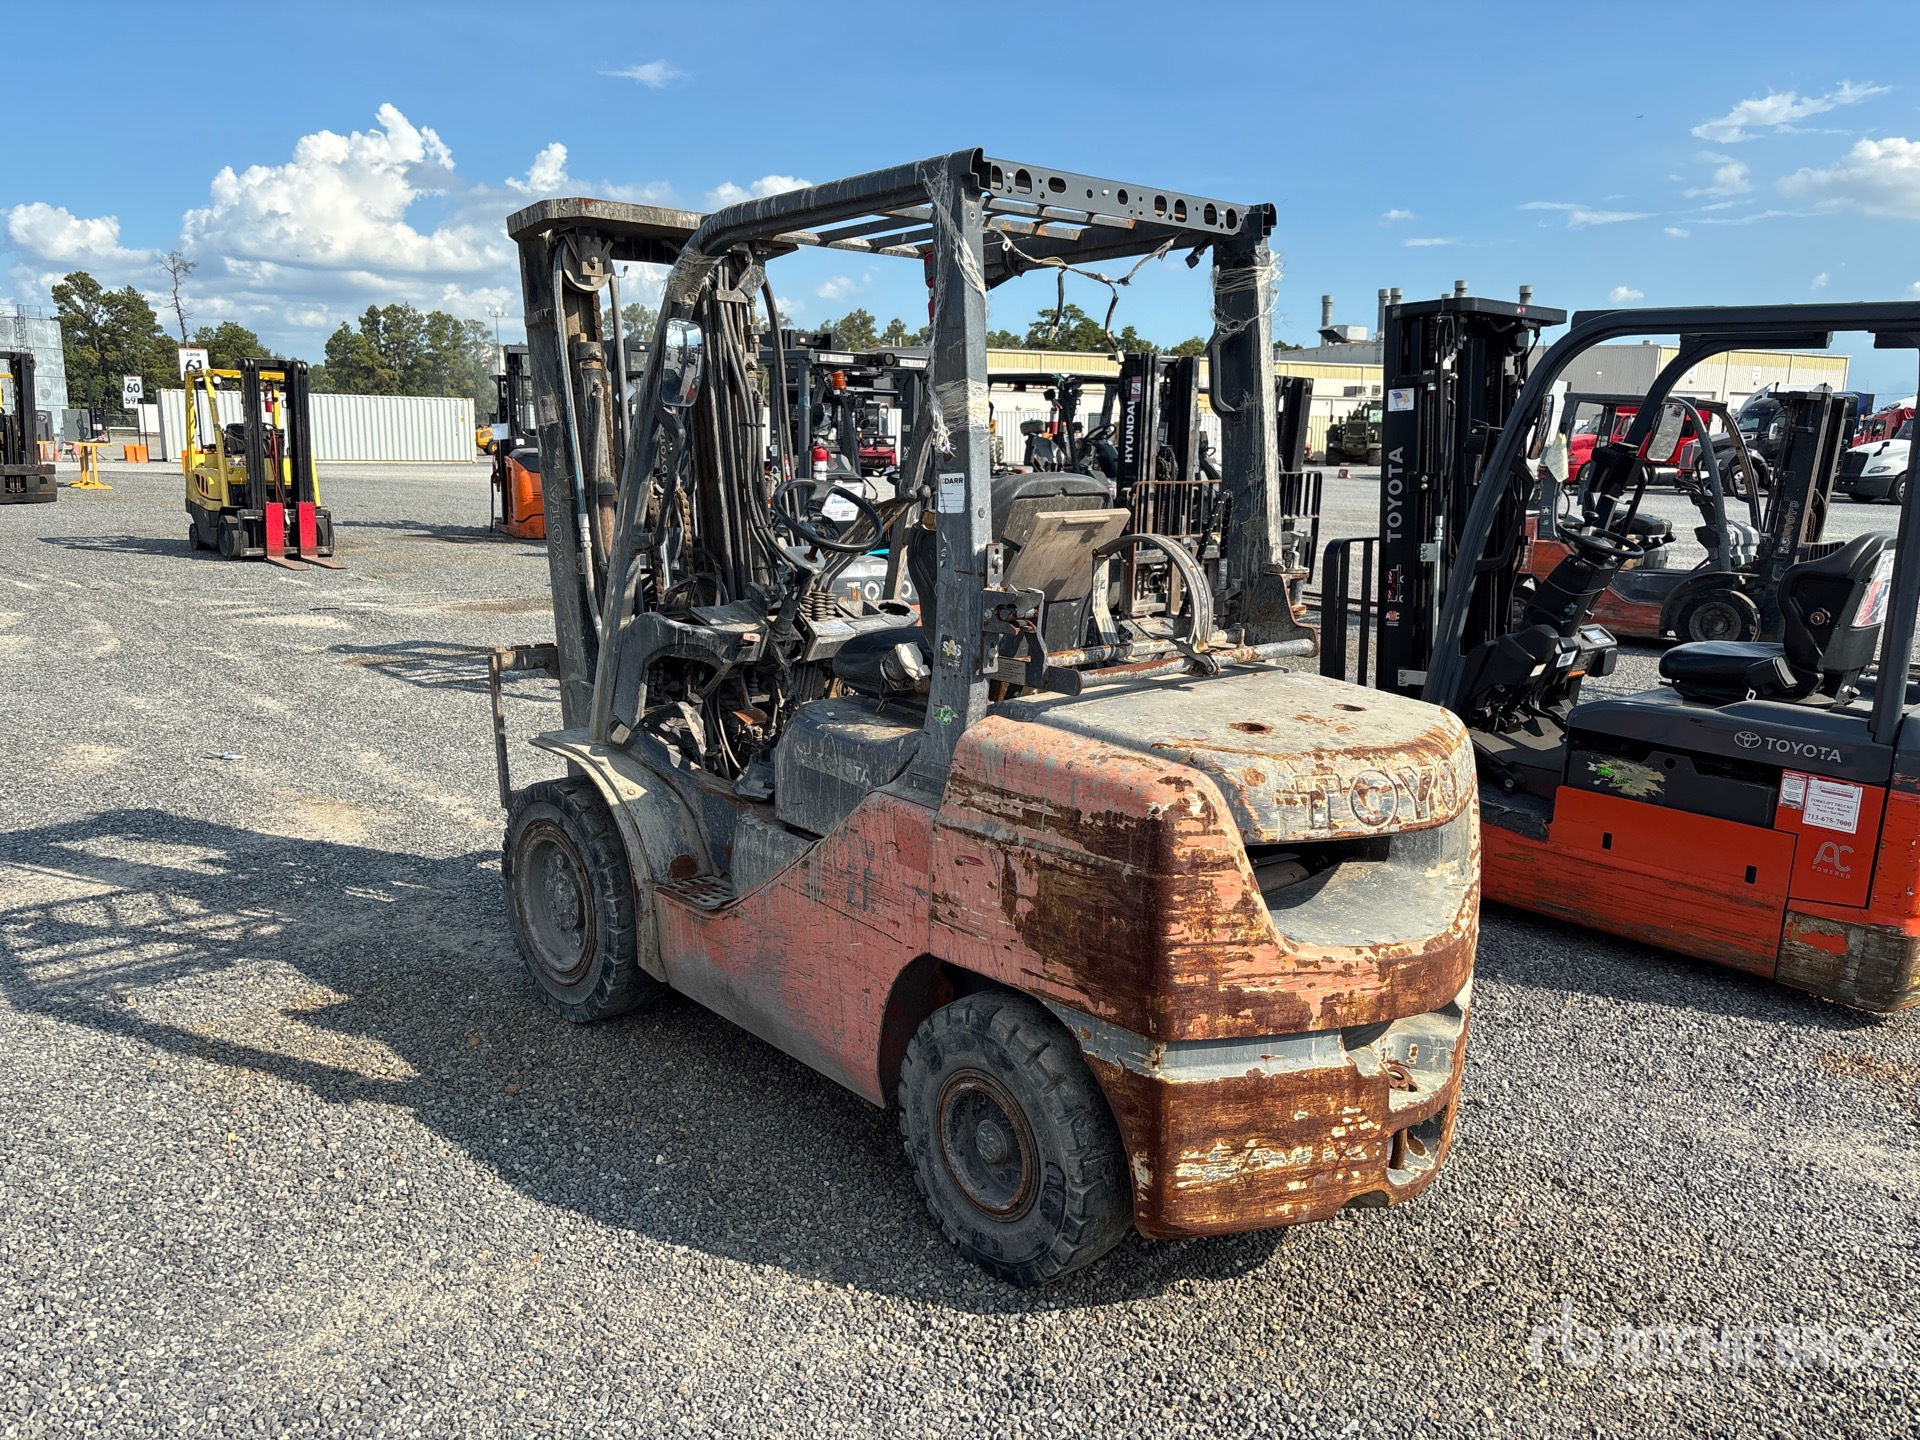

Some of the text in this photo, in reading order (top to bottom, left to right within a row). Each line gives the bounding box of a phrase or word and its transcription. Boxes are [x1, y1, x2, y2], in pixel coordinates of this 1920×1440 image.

[126, 382, 141, 393] 60
[125, 397, 136, 405] 59
[1124, 400, 1136, 464] HYUNDAI
[944, 477, 964, 485] DARR
[1386, 446, 1404, 543] TOYOTA
[1764, 736, 1842, 763] TOYOTA
[1807, 813, 1853, 828] 713-675-7000
[1813, 841, 1855, 873] AC
[1811, 865, 1851, 879] POWERED
